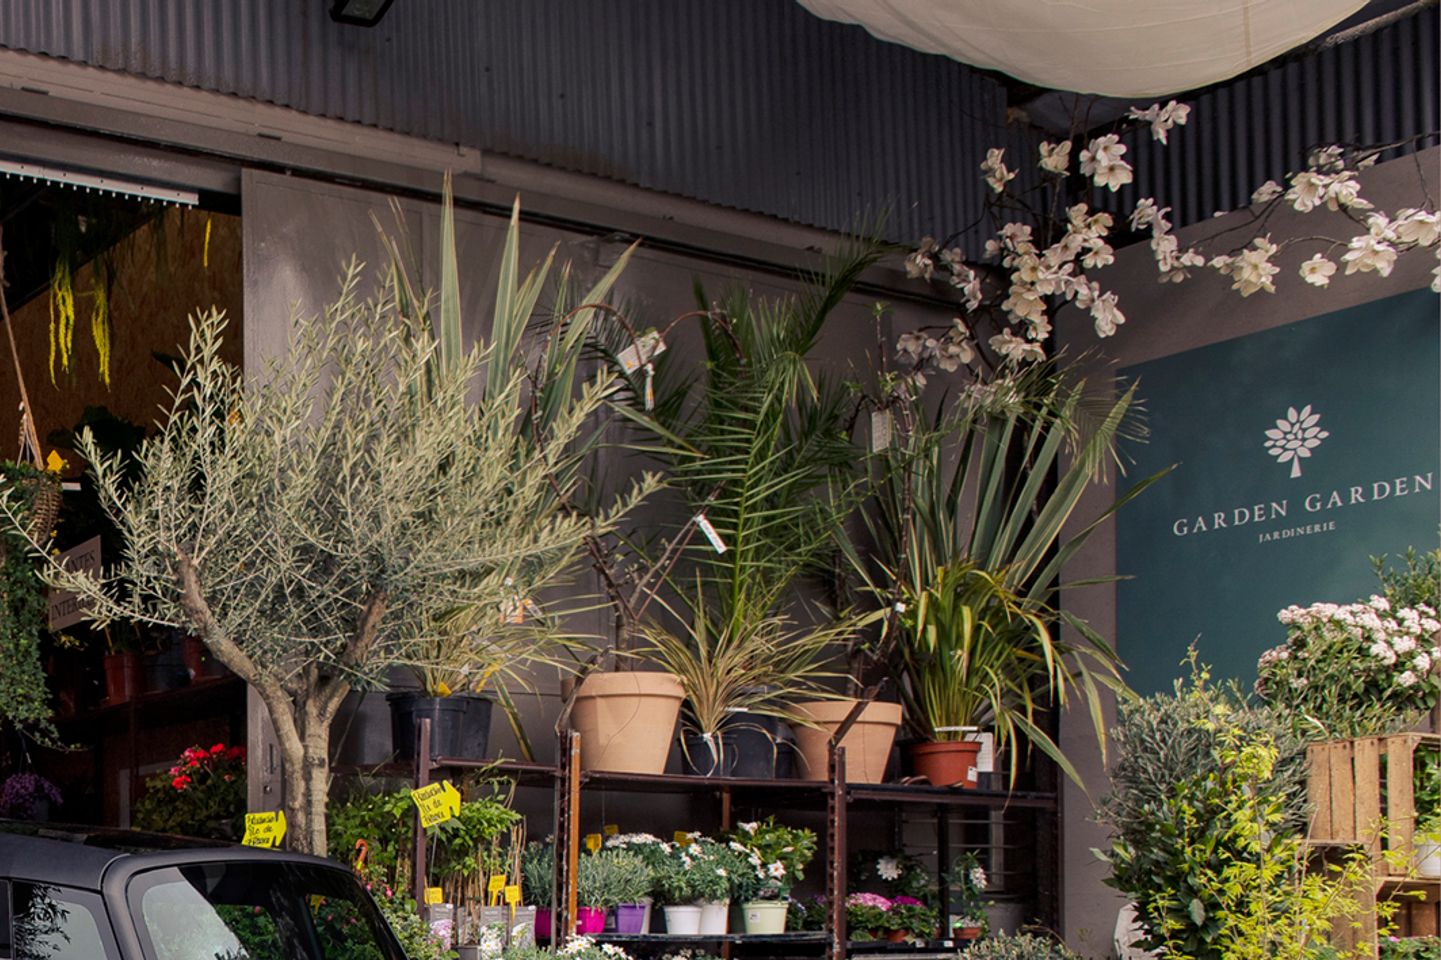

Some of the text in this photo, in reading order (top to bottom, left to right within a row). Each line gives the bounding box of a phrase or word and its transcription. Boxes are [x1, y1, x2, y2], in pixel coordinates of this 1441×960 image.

[1173, 472, 1434, 537] GARDEN GARDEN
[1258, 520, 1337, 544] JARDINERIE
